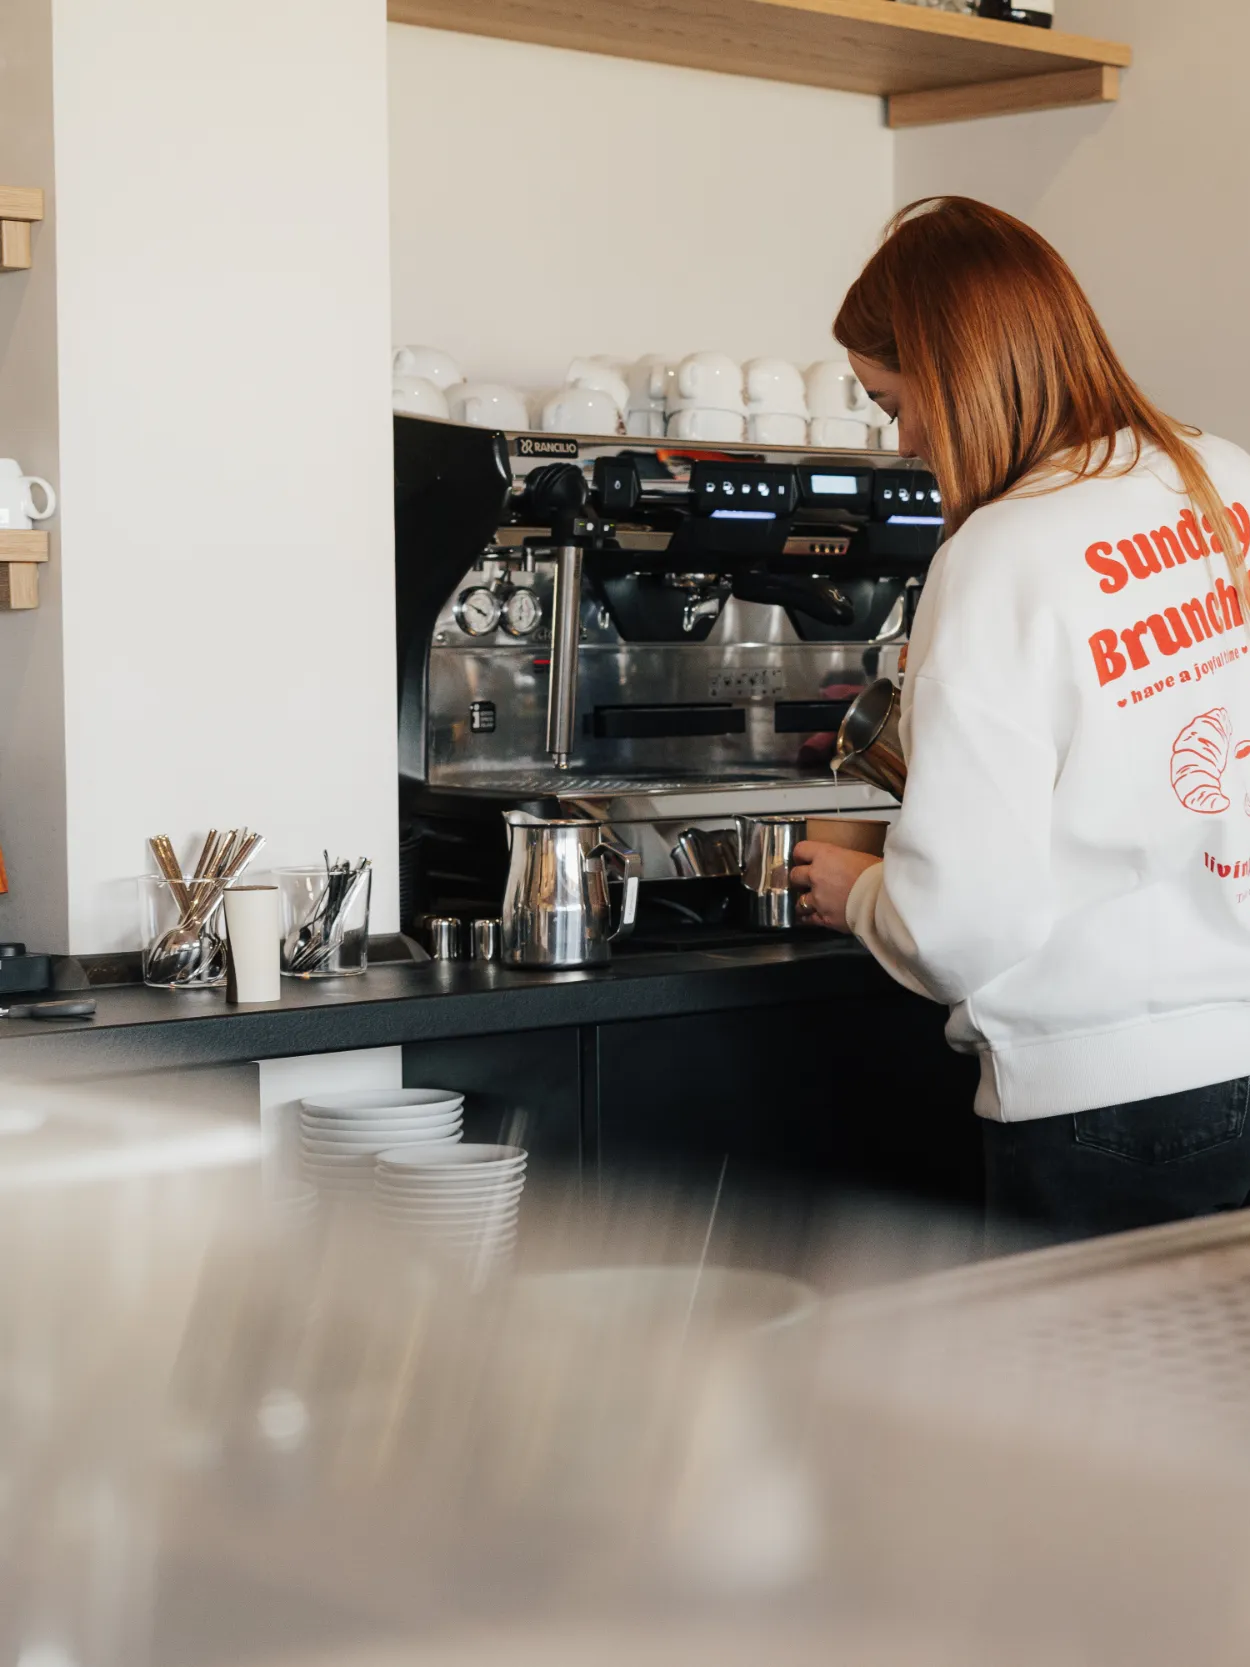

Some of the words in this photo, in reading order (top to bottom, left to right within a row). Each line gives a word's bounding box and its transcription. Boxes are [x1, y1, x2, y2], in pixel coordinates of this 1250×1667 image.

[533, 442, 577, 453] RANCILIO
[1088, 577, 1245, 688] Brunch
[1130, 675, 1175, 704] have
[1179, 669, 1192, 683] a
[1193, 654, 1225, 682] joyful
[1203, 851, 1250, 879] livin
